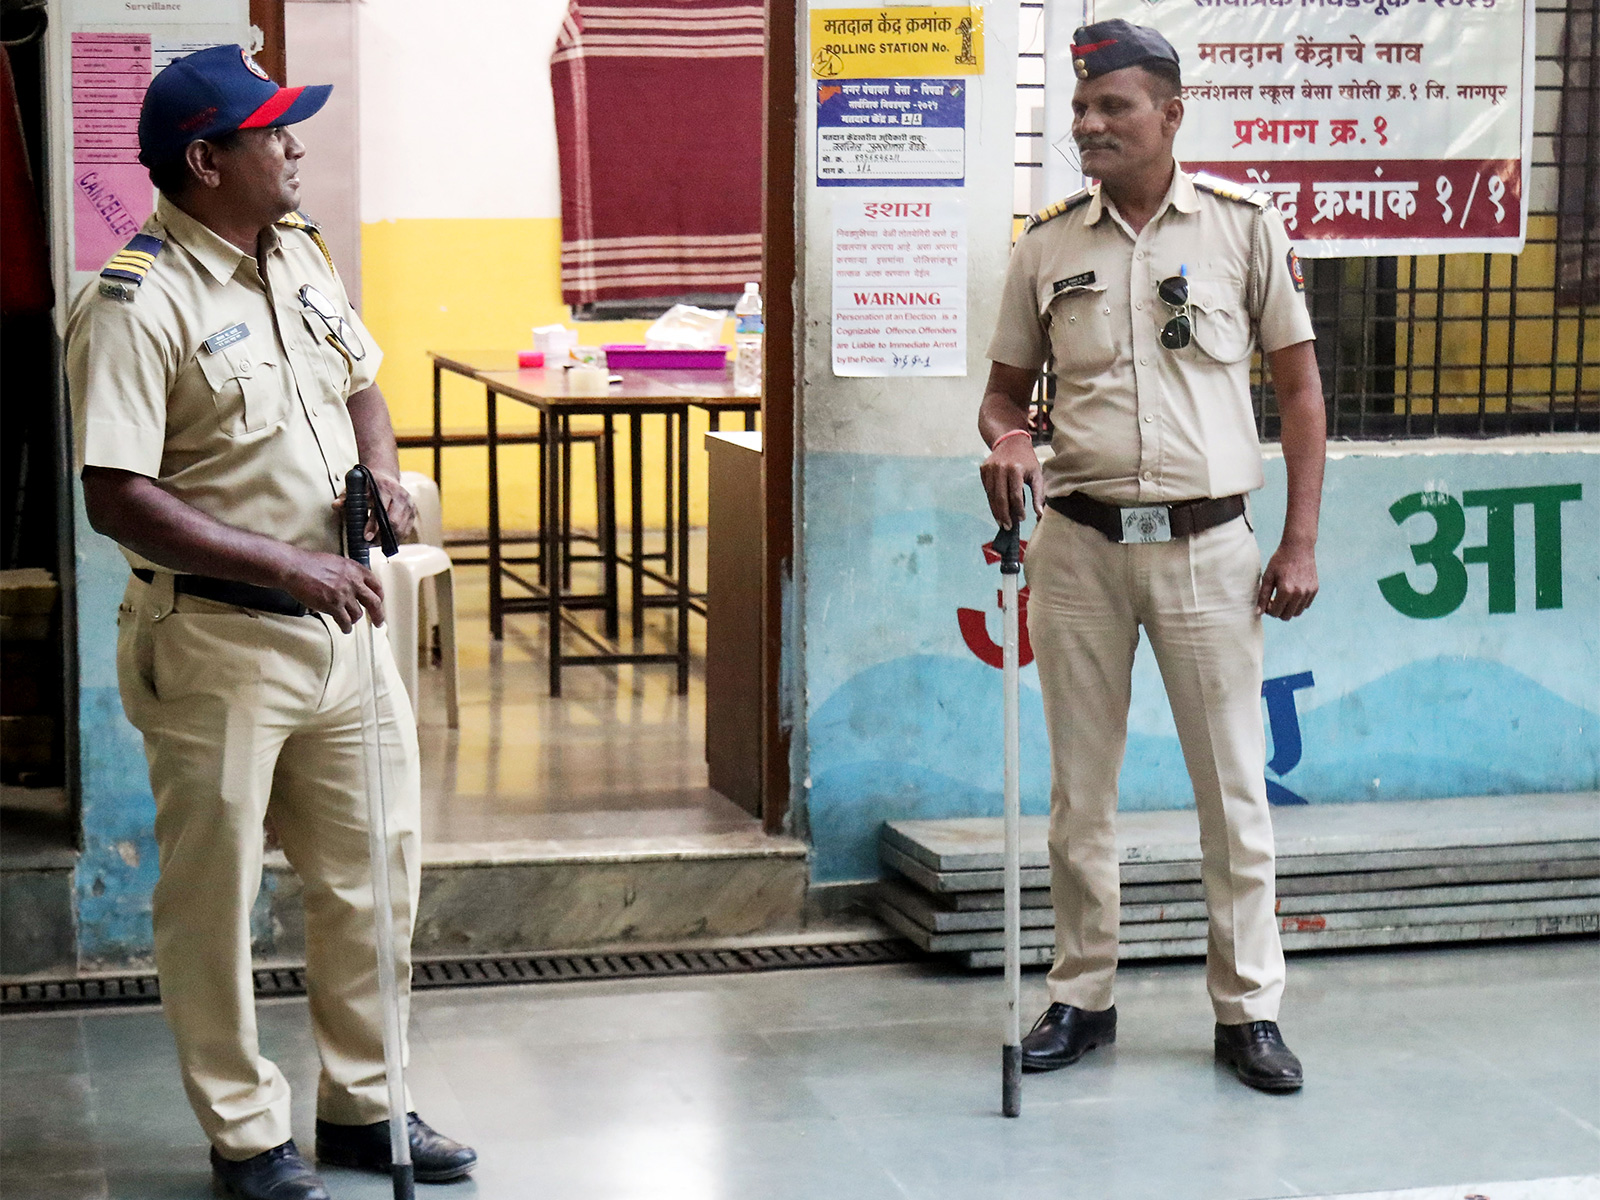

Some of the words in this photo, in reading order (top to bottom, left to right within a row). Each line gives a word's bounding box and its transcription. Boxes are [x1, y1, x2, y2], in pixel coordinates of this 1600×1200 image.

[125, 2, 182, 11] Surveillance
[824, 18, 873, 35] मतदान
[877, 12, 901, 36] केंद्र
[906, 11, 952, 35] क्रमांक
[826, 43, 876, 55] POLLING
[879, 42, 928, 54] STATION
[932, 42, 950, 53] No.
[1198, 42, 1285, 69] मतदान
[1294, 34, 1366, 69] केंद्राचे
[1375, 42, 1424, 64] नाव
[1181, 80, 1254, 101] टरनॅशनल
[1259, 85, 1296, 105] स्कूल
[1301, 80, 1333, 100] बेसा
[1338, 79, 1382, 100] खोली
[1425, 80, 1449, 100] जि.
[1457, 85, 1508, 106] नागपूर
[1232, 118, 1319, 148] प्रभाग
[1311, 167, 1420, 225] क्रमांक
[863, 202, 932, 219] इशारा
[853, 292, 941, 306] WARNING
[837, 313, 884, 321] Personation
[905, 313, 936, 321] Election
[836, 327, 880, 337] Cognizable
[919, 327, 958, 335] Offenders
[852, 341, 875, 349] Liable
[889, 341, 930, 349] Immediate
[837, 356, 846, 364] by
[848, 355, 859, 363] the
[1377, 483, 1584, 620] आ
